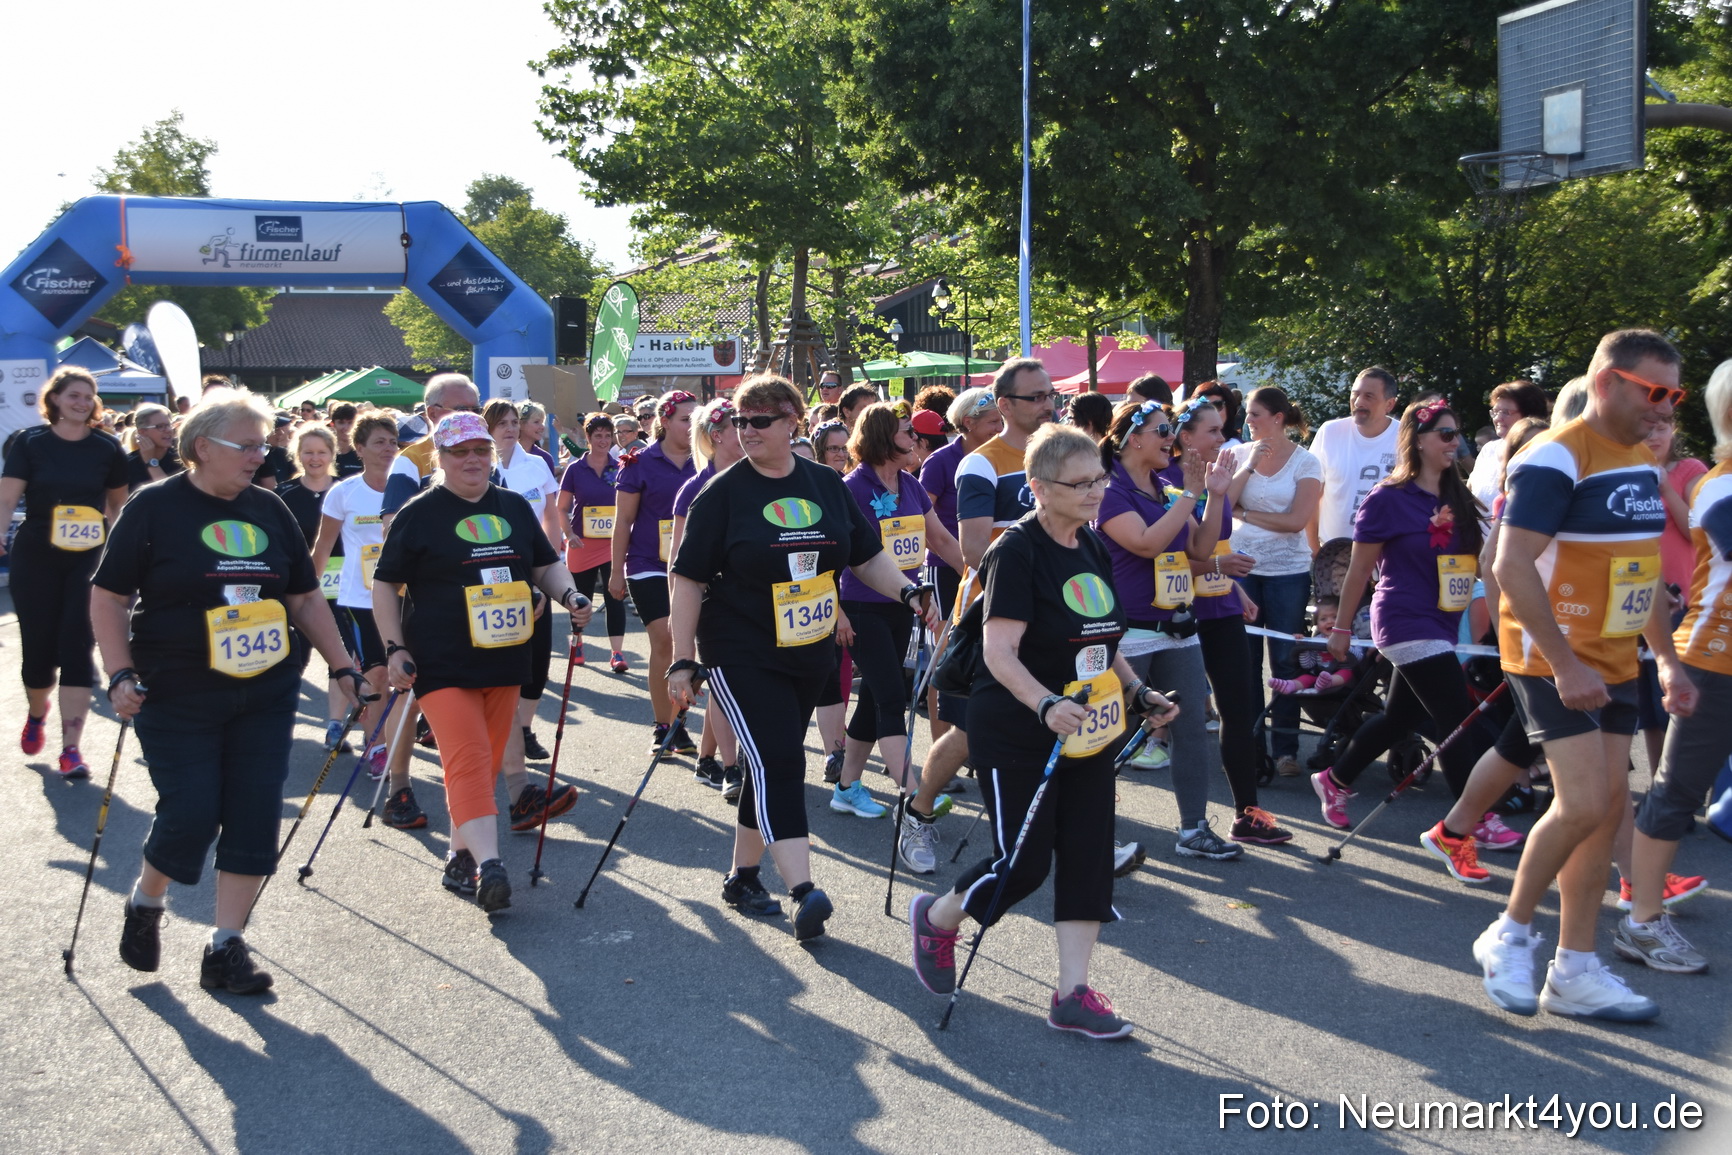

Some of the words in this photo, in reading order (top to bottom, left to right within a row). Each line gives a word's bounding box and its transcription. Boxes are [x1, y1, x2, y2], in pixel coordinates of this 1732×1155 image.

[265, 225, 300, 233] Fischer
[240, 242, 342, 261] firmenlauf
[35, 277, 95, 289] Fischer
[462, 277, 477, 285] das
[612, 327, 633, 360] AOK
[592, 350, 615, 386] AOK
[60, 523, 101, 539] 1245
[590, 519, 613, 529] 706
[471, 549, 514, 557] Adipositas-Neumarkt
[893, 536, 919, 556] 696
[1166, 574, 1188, 593] 700
[1449, 577, 1470, 596] 699
[1621, 587, 1652, 615] 458
[477, 606, 526, 630] 1351
[784, 598, 833, 629] 1346
[221, 628, 282, 660] 1343
